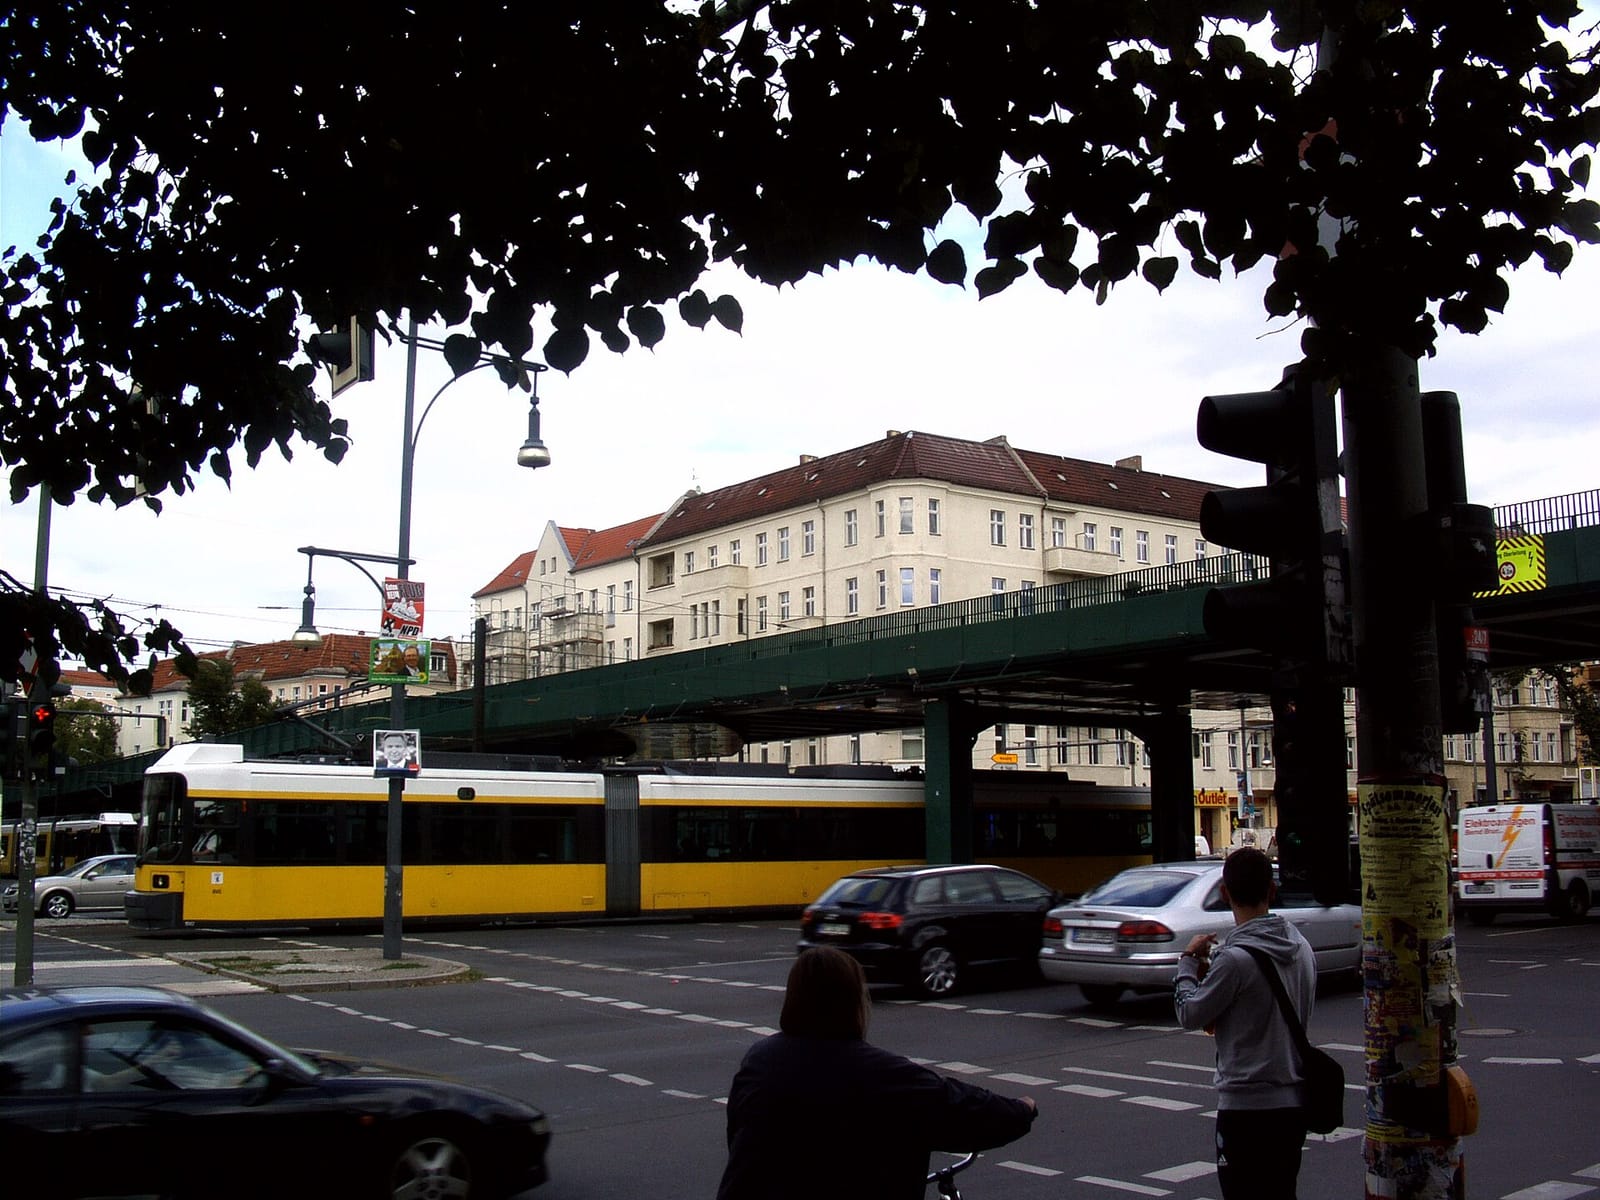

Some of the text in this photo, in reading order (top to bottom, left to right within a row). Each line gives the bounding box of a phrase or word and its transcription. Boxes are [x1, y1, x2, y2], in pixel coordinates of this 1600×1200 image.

[400, 625, 419, 636] NPD
[1198, 792, 1227, 805] Outlet
[1464, 818, 1535, 829] Elektroanlagen
